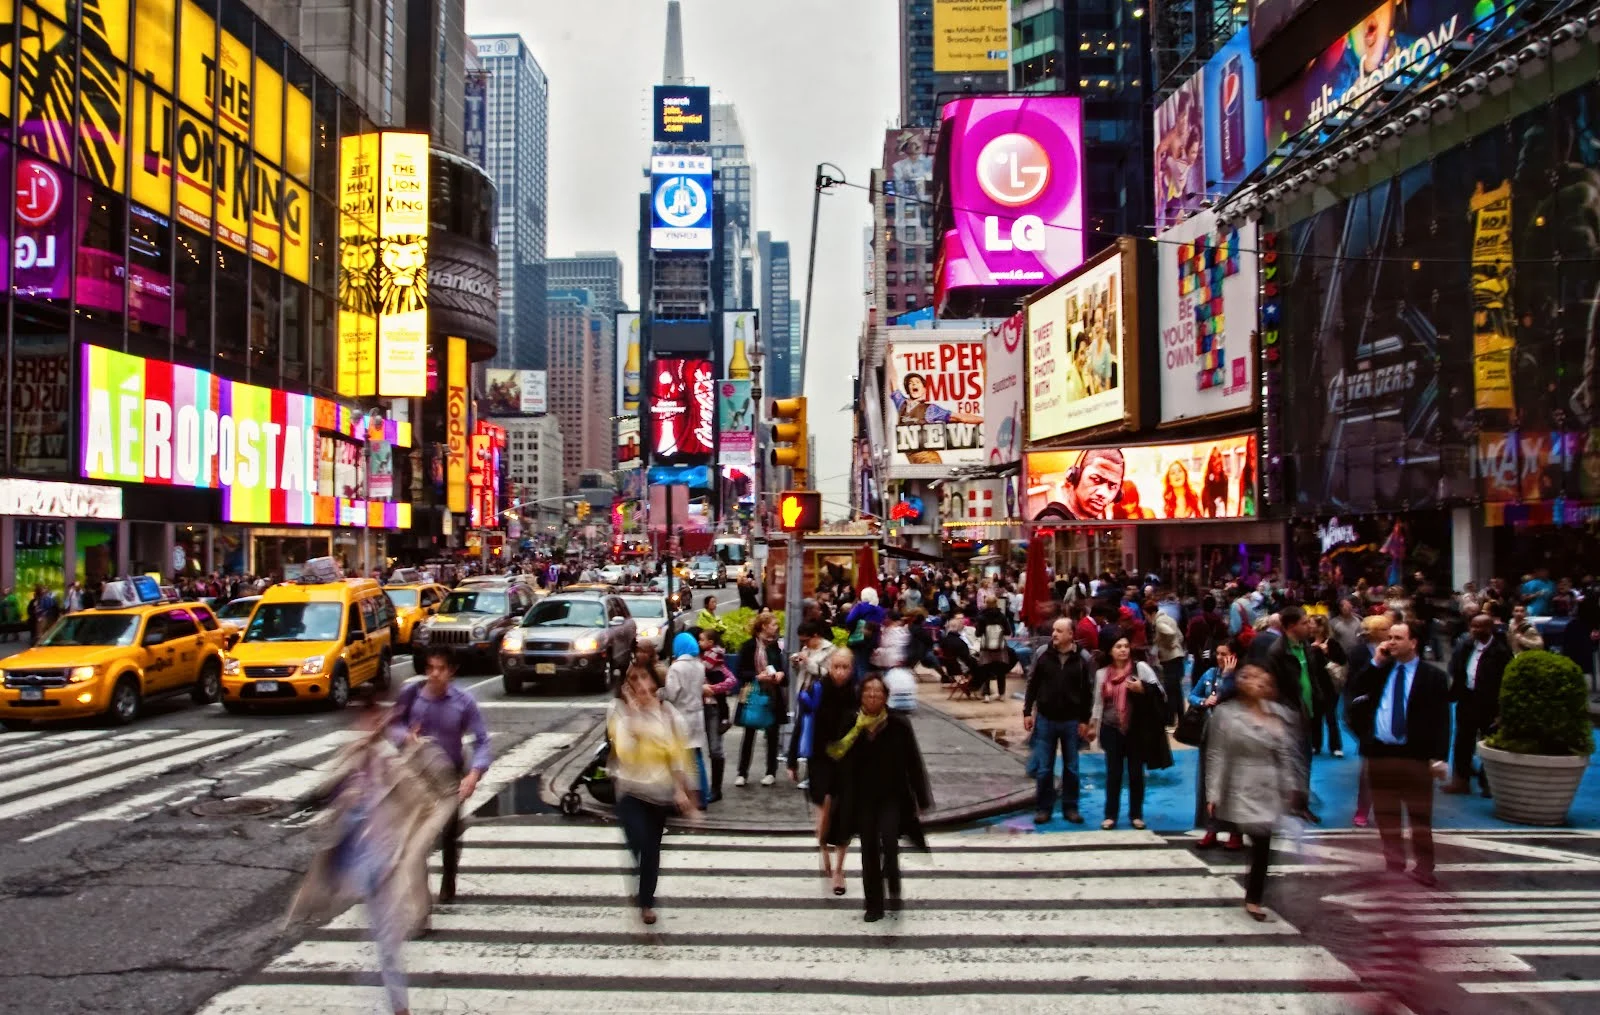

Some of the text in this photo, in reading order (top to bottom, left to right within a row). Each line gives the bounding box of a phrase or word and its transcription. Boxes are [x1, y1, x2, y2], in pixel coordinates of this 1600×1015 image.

[947, 35, 984, 44] Broadway
[201, 53, 250, 122] THE
[144, 68, 226, 193] LION
[392, 164, 415, 174] THE
[231, 130, 301, 237] KING
[388, 176, 420, 192] LION
[386, 195, 423, 213] KING
[984, 214, 1046, 252] LG
[1178, 298, 1192, 321] BE
[1033, 321, 1053, 342] TWEET
[1162, 321, 1194, 348] YOUR
[904, 351, 935, 371] THE
[1034, 358, 1056, 379] PHOTO
[1166, 343, 1194, 370] OWN
[925, 371, 982, 402] MUS
[958, 401, 980, 414] FOR
[84, 374, 318, 496] AÉROPOSTAL
[449, 385, 466, 467] Kodak
